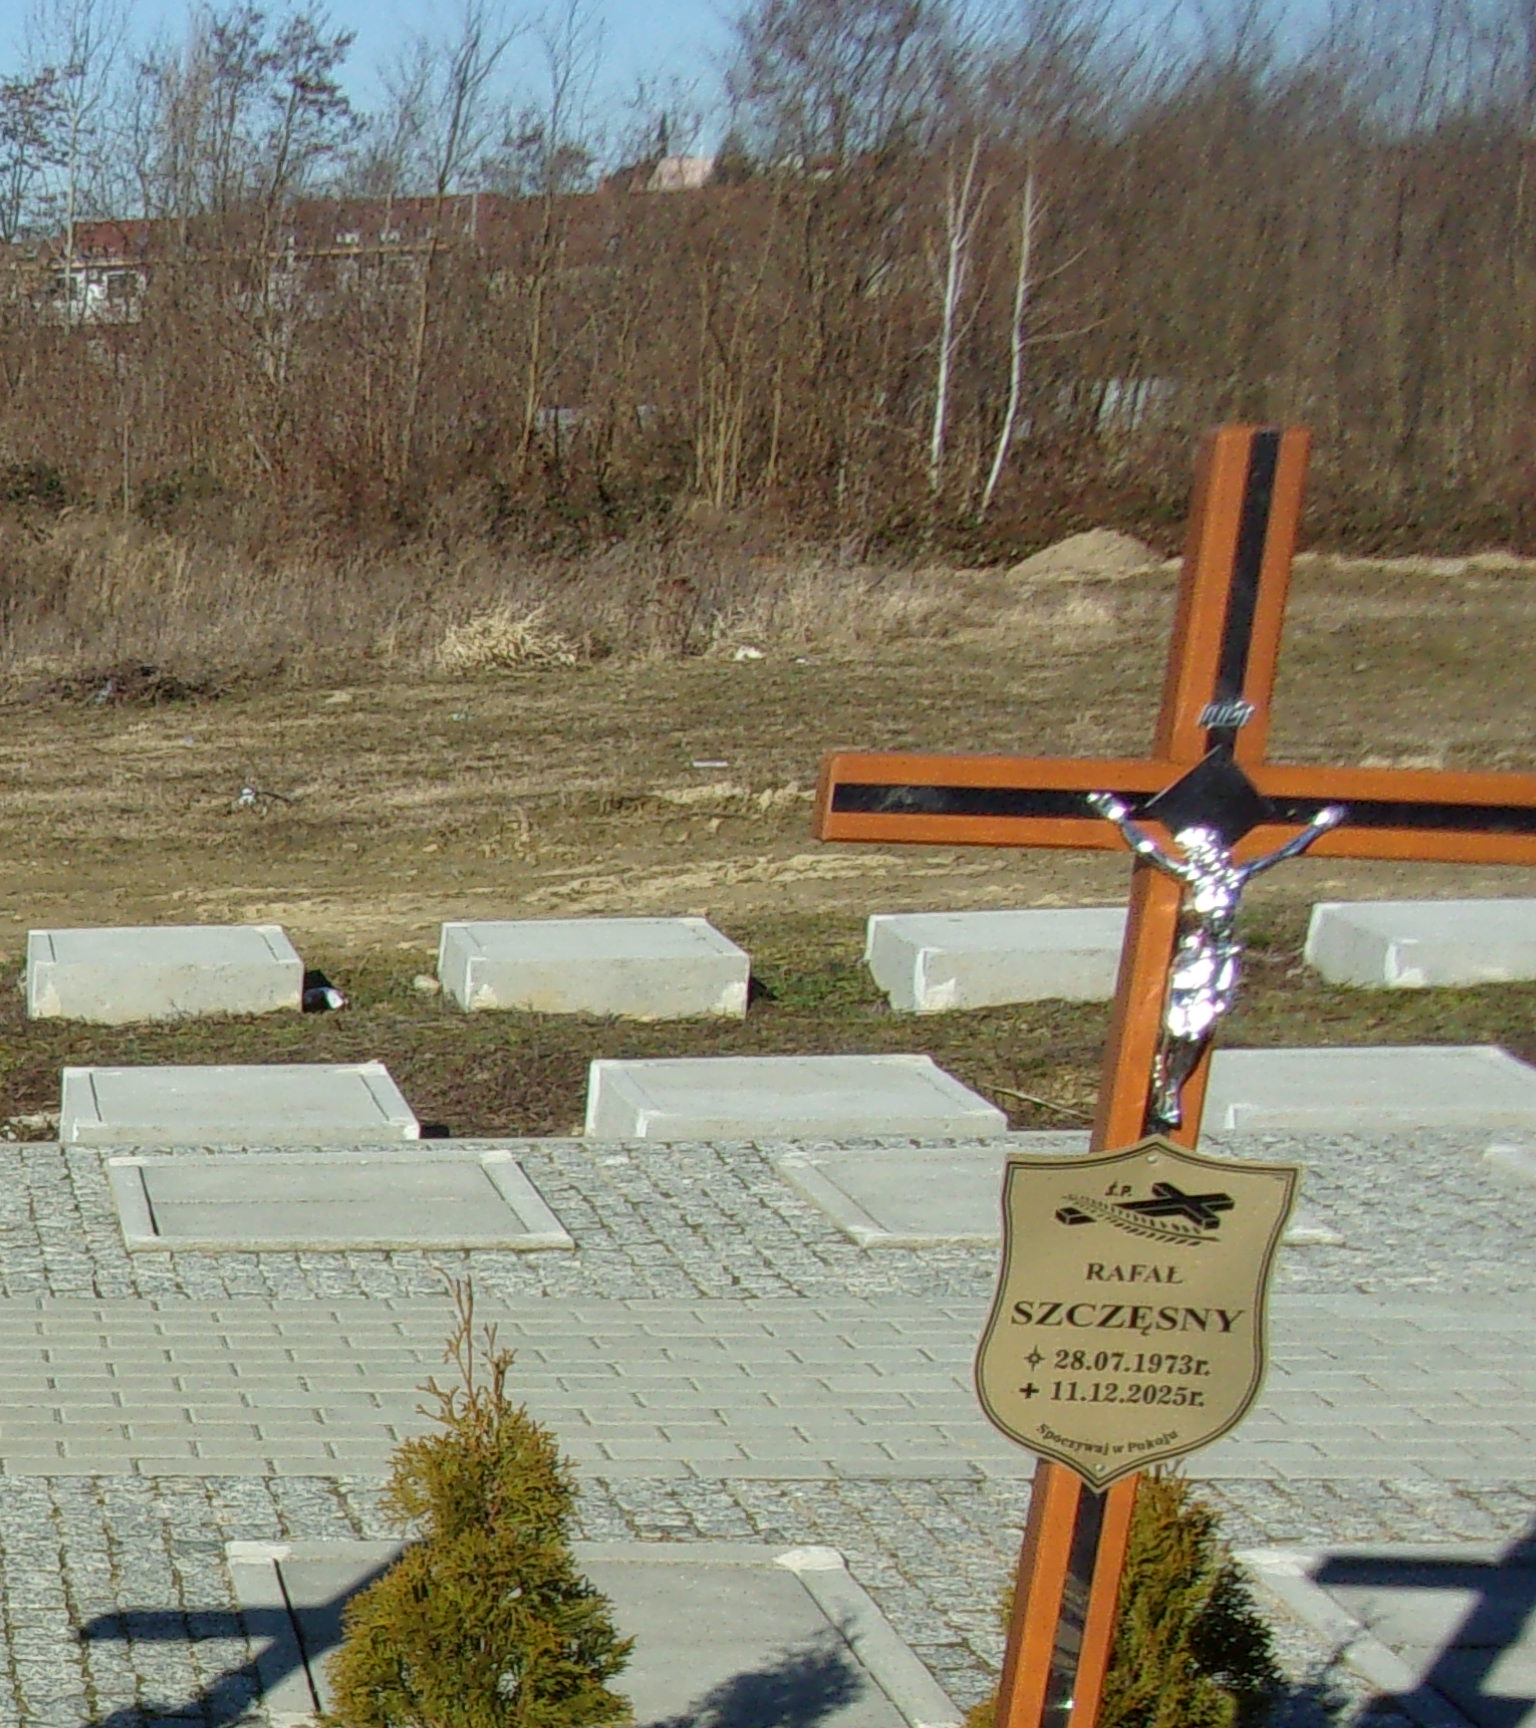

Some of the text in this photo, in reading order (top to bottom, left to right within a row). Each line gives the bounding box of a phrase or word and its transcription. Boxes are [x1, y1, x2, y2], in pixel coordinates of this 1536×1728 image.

[1085, 1262, 1184, 1284] RAFAŁ
[1011, 1300, 1246, 1337] SZCZĘSNY
[1054, 1349, 1211, 1377] 28.07.1973r.
[1050, 1380, 1206, 1408] 11.12.2025r.
[1036, 1423, 1179, 1456] Spoczywaj w Pokoju
